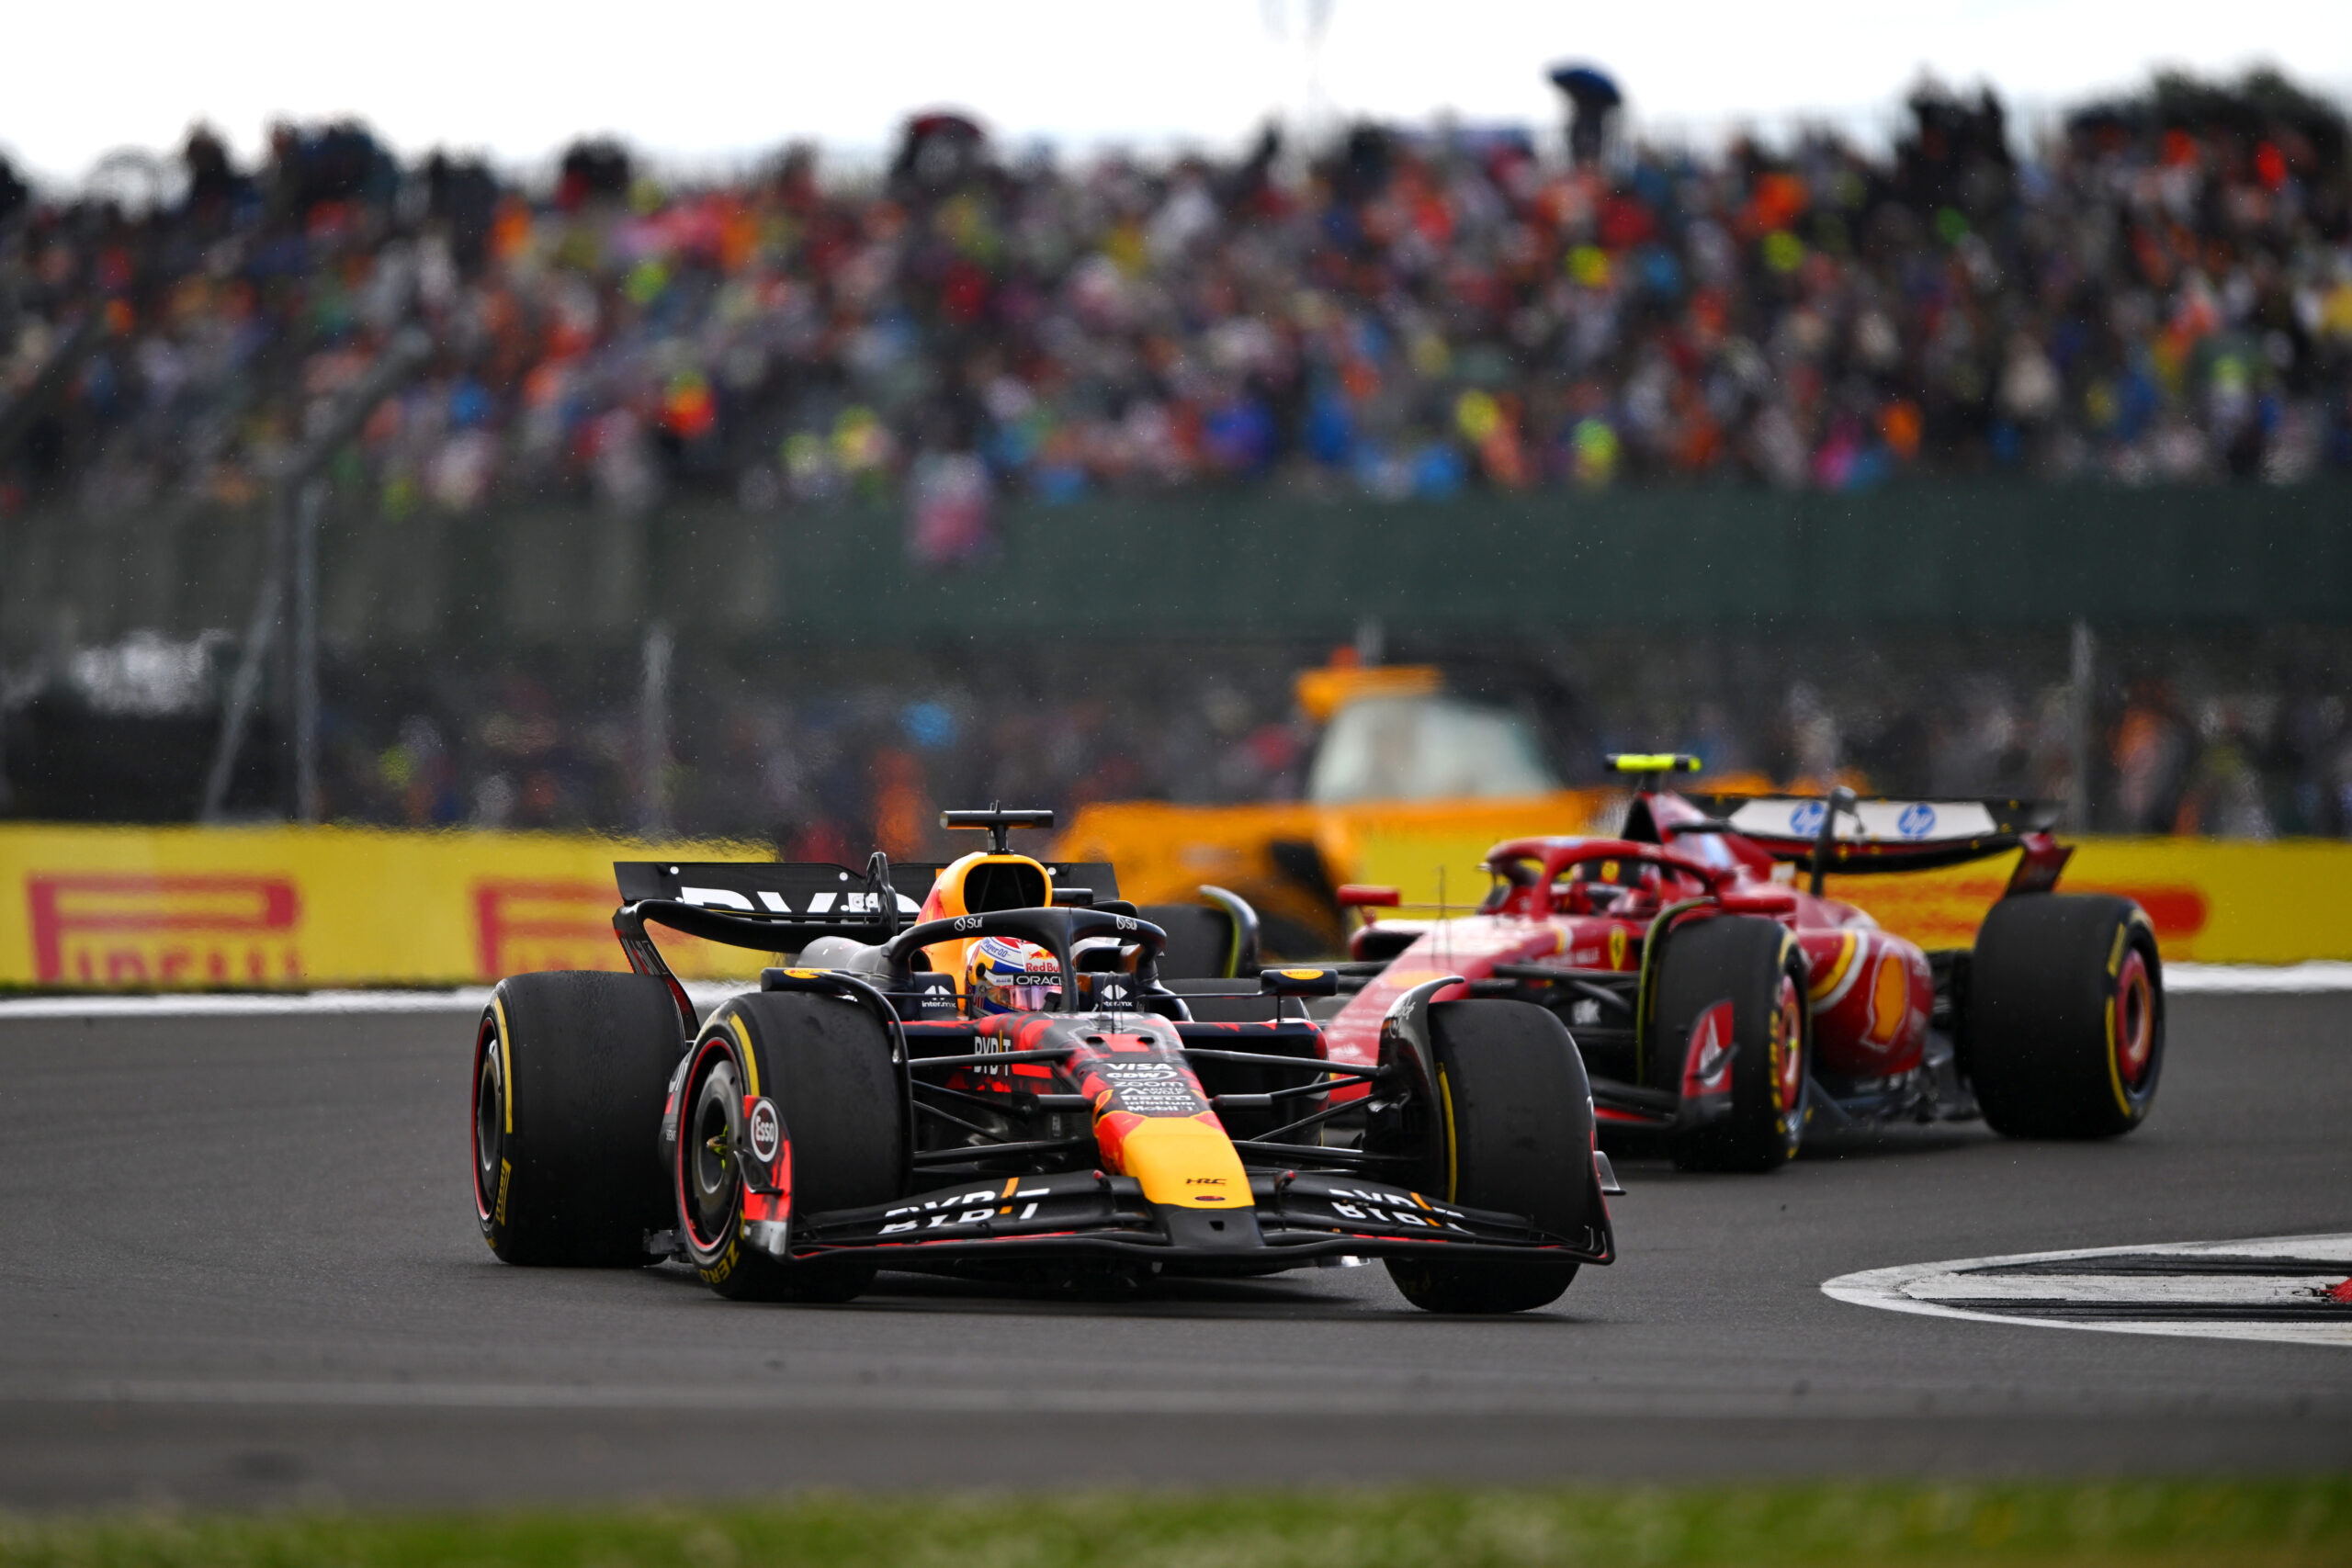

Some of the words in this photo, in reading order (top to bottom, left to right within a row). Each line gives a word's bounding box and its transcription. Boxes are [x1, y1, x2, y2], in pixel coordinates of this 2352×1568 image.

[967, 917, 984, 929] Sui
[1025, 963, 1046, 972] Red
[1016, 976, 1061, 986] ORACL
[1104, 1063, 1173, 1071] VISA
[1186, 1178, 1227, 1186] HRC
